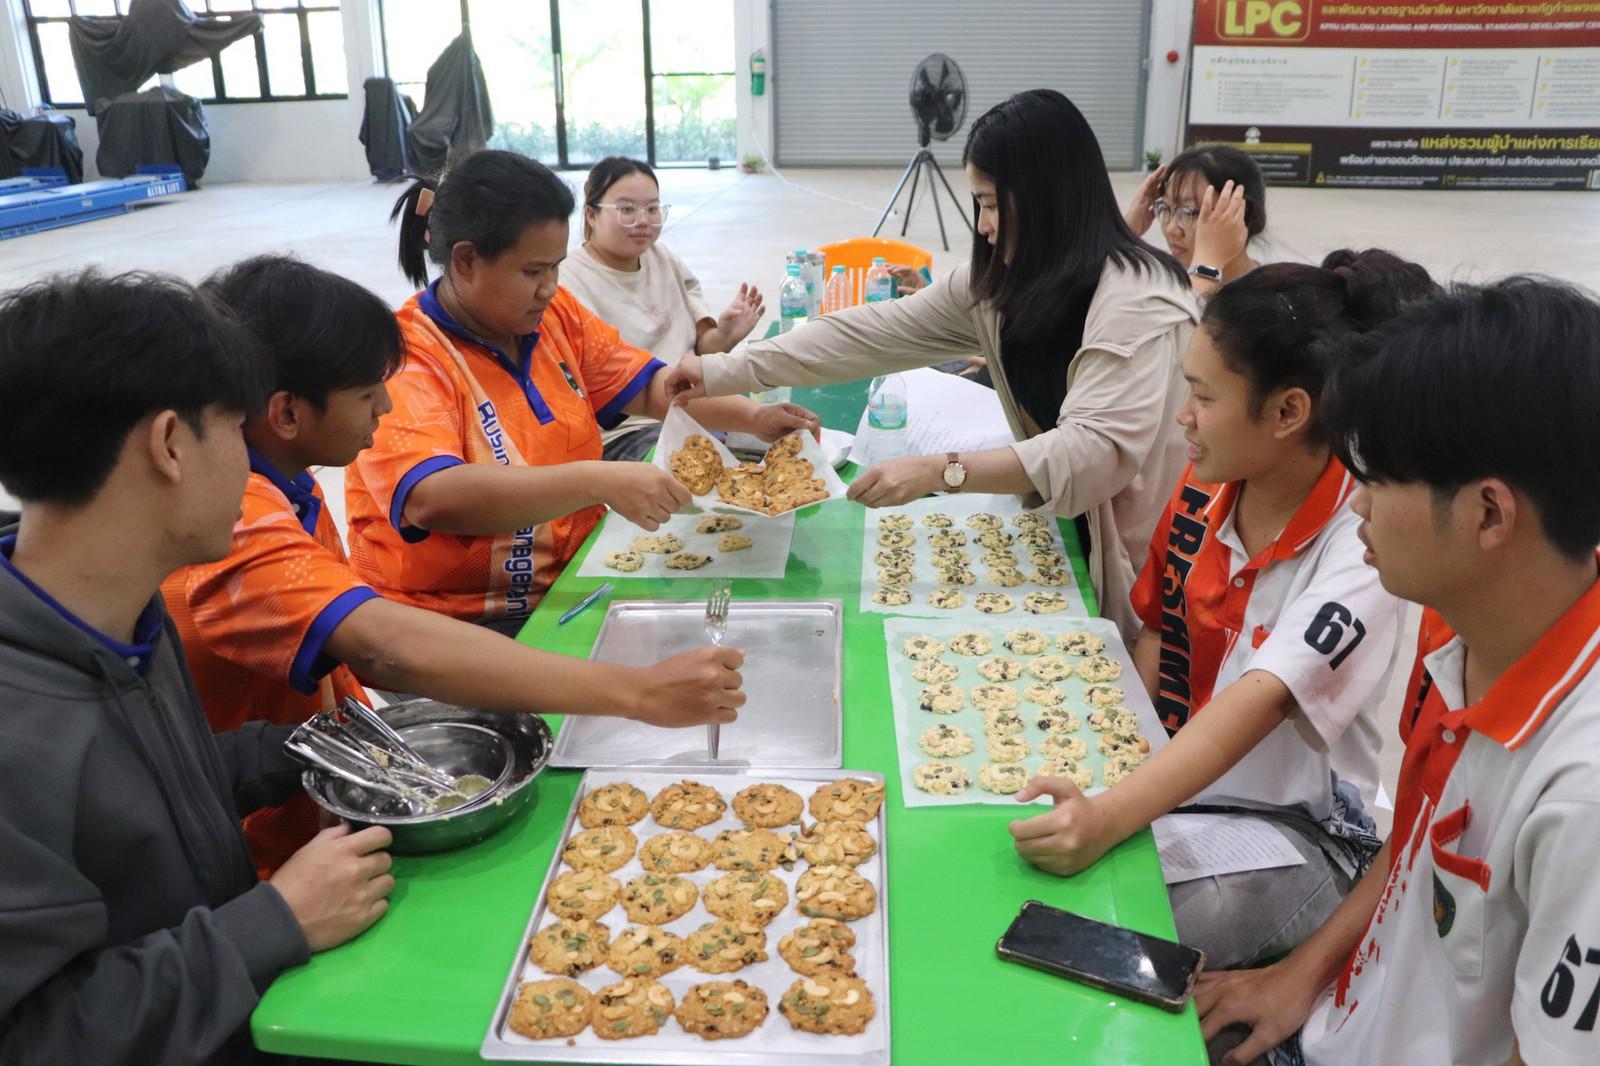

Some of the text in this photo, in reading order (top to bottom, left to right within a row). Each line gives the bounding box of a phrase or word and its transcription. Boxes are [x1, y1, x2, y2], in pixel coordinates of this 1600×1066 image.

[1225, 0, 1303, 36] LPC
[1341, 23, 1375, 32] LIFELONG
[1376, 23, 1412, 32] LEARNING
[1413, 23, 1429, 31] AND
[1430, 23, 1483, 31] PROFESSIONAL
[1484, 22, 1529, 31] STANDARDS
[1530, 21, 1584, 30] DEVELOPMENT
[1420, 133, 1600, 154] แหล่งรวมผู้นำแห่งการเรีย
[1157, 483, 1212, 740] FRESHME
[1304, 601, 1367, 672] 67
[1541, 933, 1600, 1032] 67
